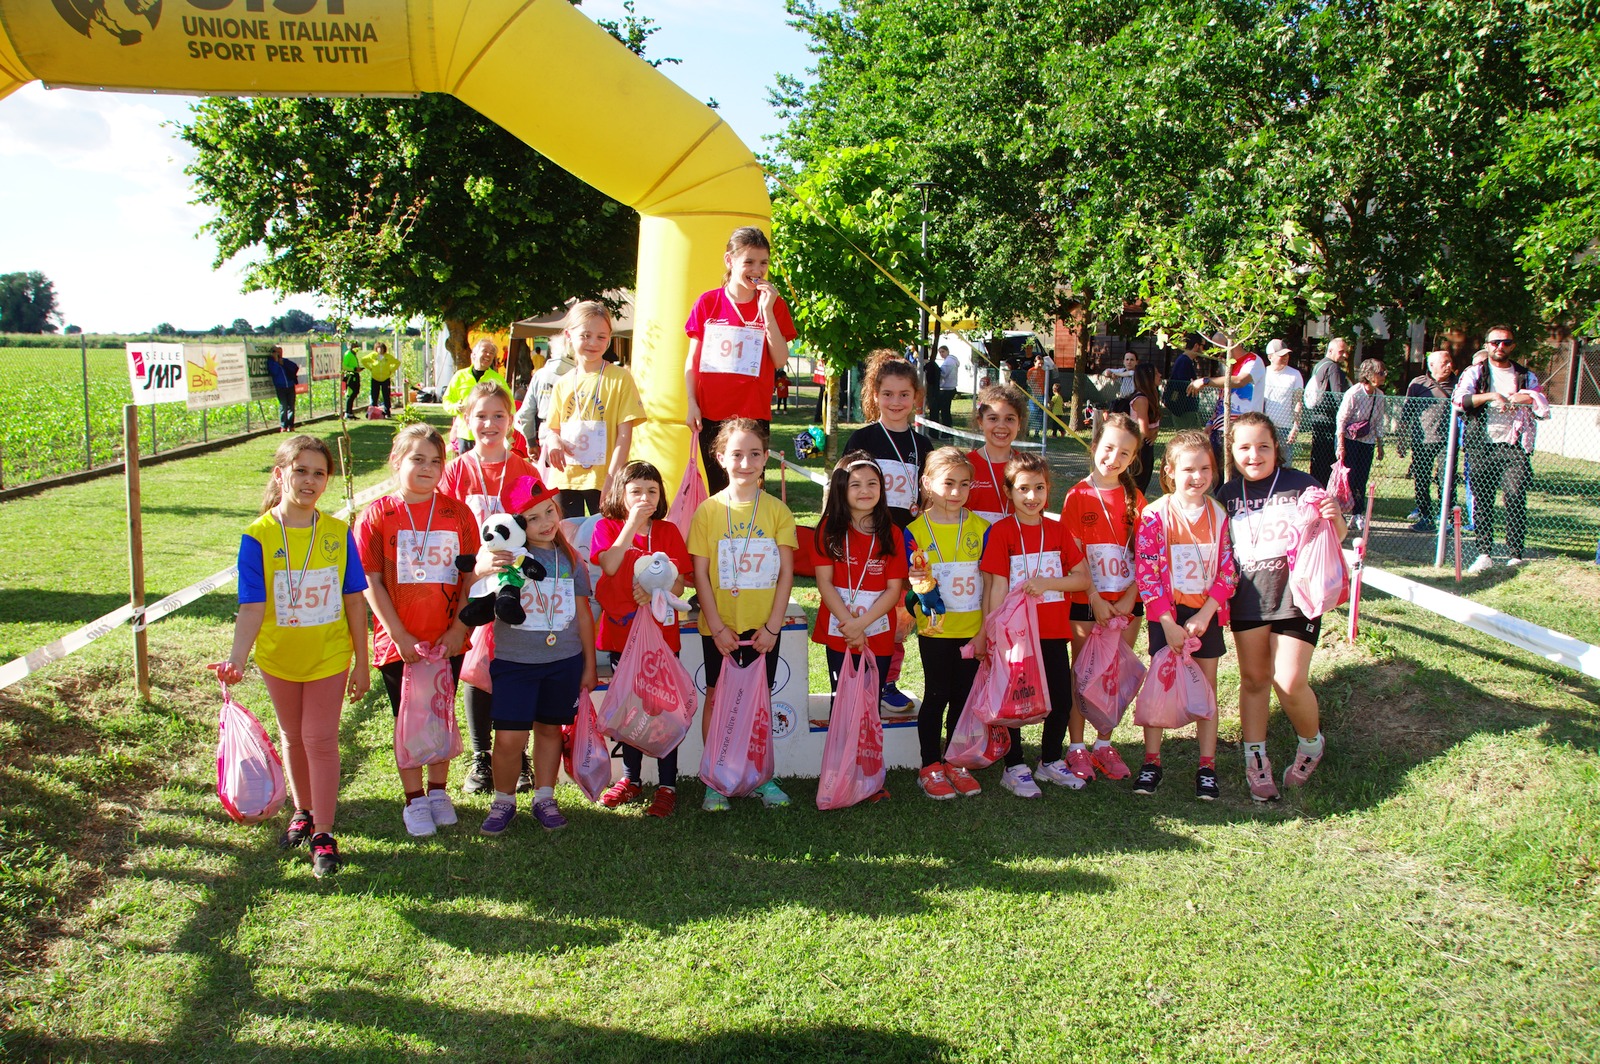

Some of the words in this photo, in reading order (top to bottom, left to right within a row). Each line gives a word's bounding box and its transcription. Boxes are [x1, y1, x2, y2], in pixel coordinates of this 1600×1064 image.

[182, 15, 270, 40] UNIONE
[279, 20, 378, 42] ITALIANA
[187, 41, 256, 61] SPORT
[266, 46, 303, 63] PER
[312, 47, 369, 64] TUTTI
[145, 351, 181, 361] SELLE
[720, 339, 744, 359] 91
[143, 364, 182, 390] SMP
[884, 473, 907, 494] 92
[1226, 493, 1297, 513] Cherries
[411, 546, 453, 567] 253
[1097, 557, 1130, 579] 108
[287, 583, 331, 609] 257
[951, 576, 976, 597] 55
[520, 593, 565, 615] 292
[645, 683, 677, 705] CONAD
[734, 687, 744, 704] cose
[731, 704, 739, 714] le
[726, 713, 738, 735] oltre
[581, 734, 595, 768] Persone
[716, 734, 733, 767] Persone
